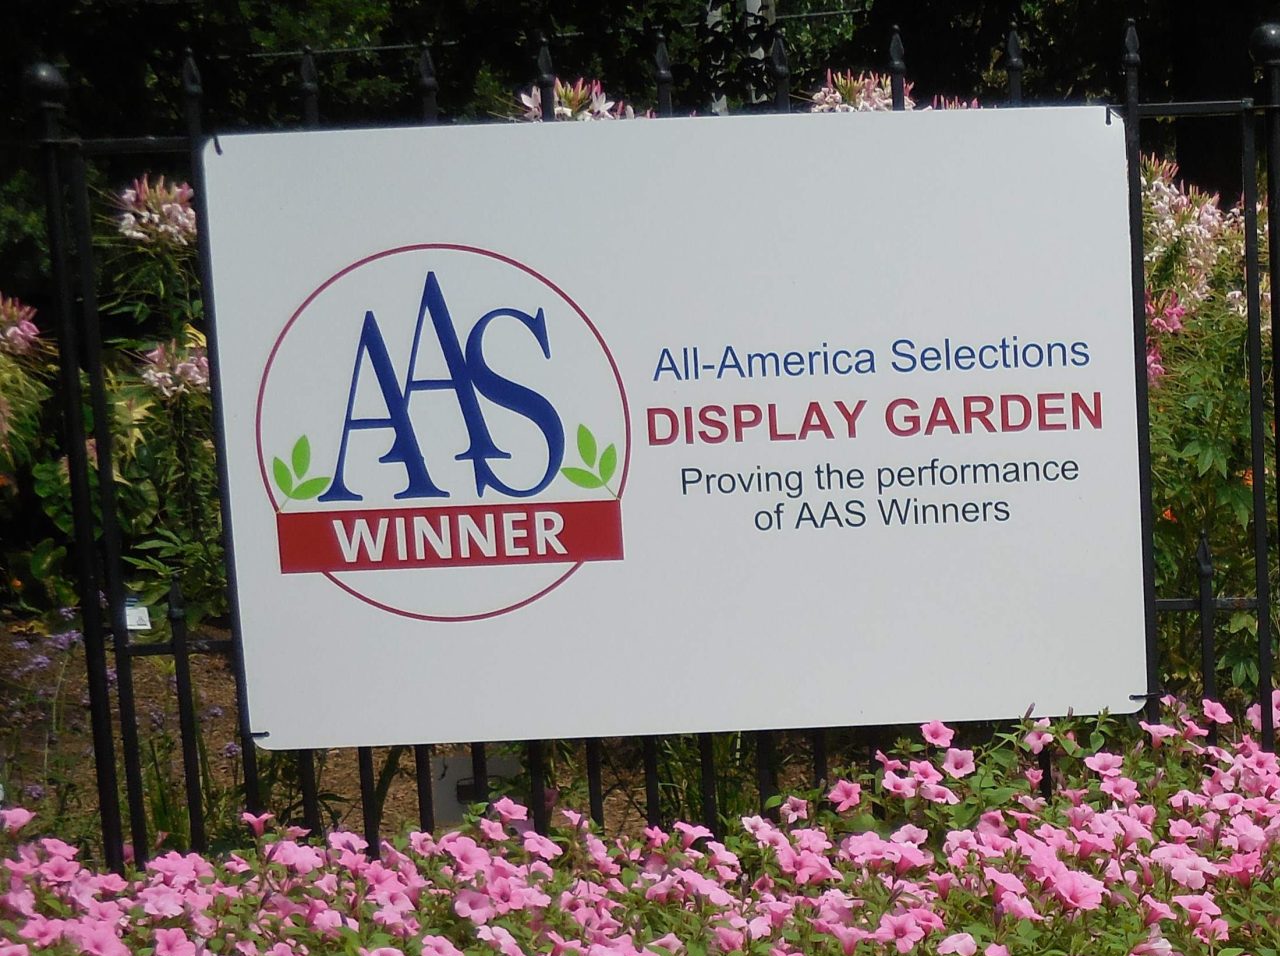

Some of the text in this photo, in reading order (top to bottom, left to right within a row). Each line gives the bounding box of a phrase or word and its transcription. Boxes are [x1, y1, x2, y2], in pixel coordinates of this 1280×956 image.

[653, 336, 1090, 382] All-America Selections
[317, 271, 566, 502] AAS
[646, 391, 1103, 446] DISPLAY GARDEN
[681, 458, 1079, 498] Proving the performance
[332, 511, 568, 563] WINNER
[754, 498, 1010, 531] of AAS Winners
